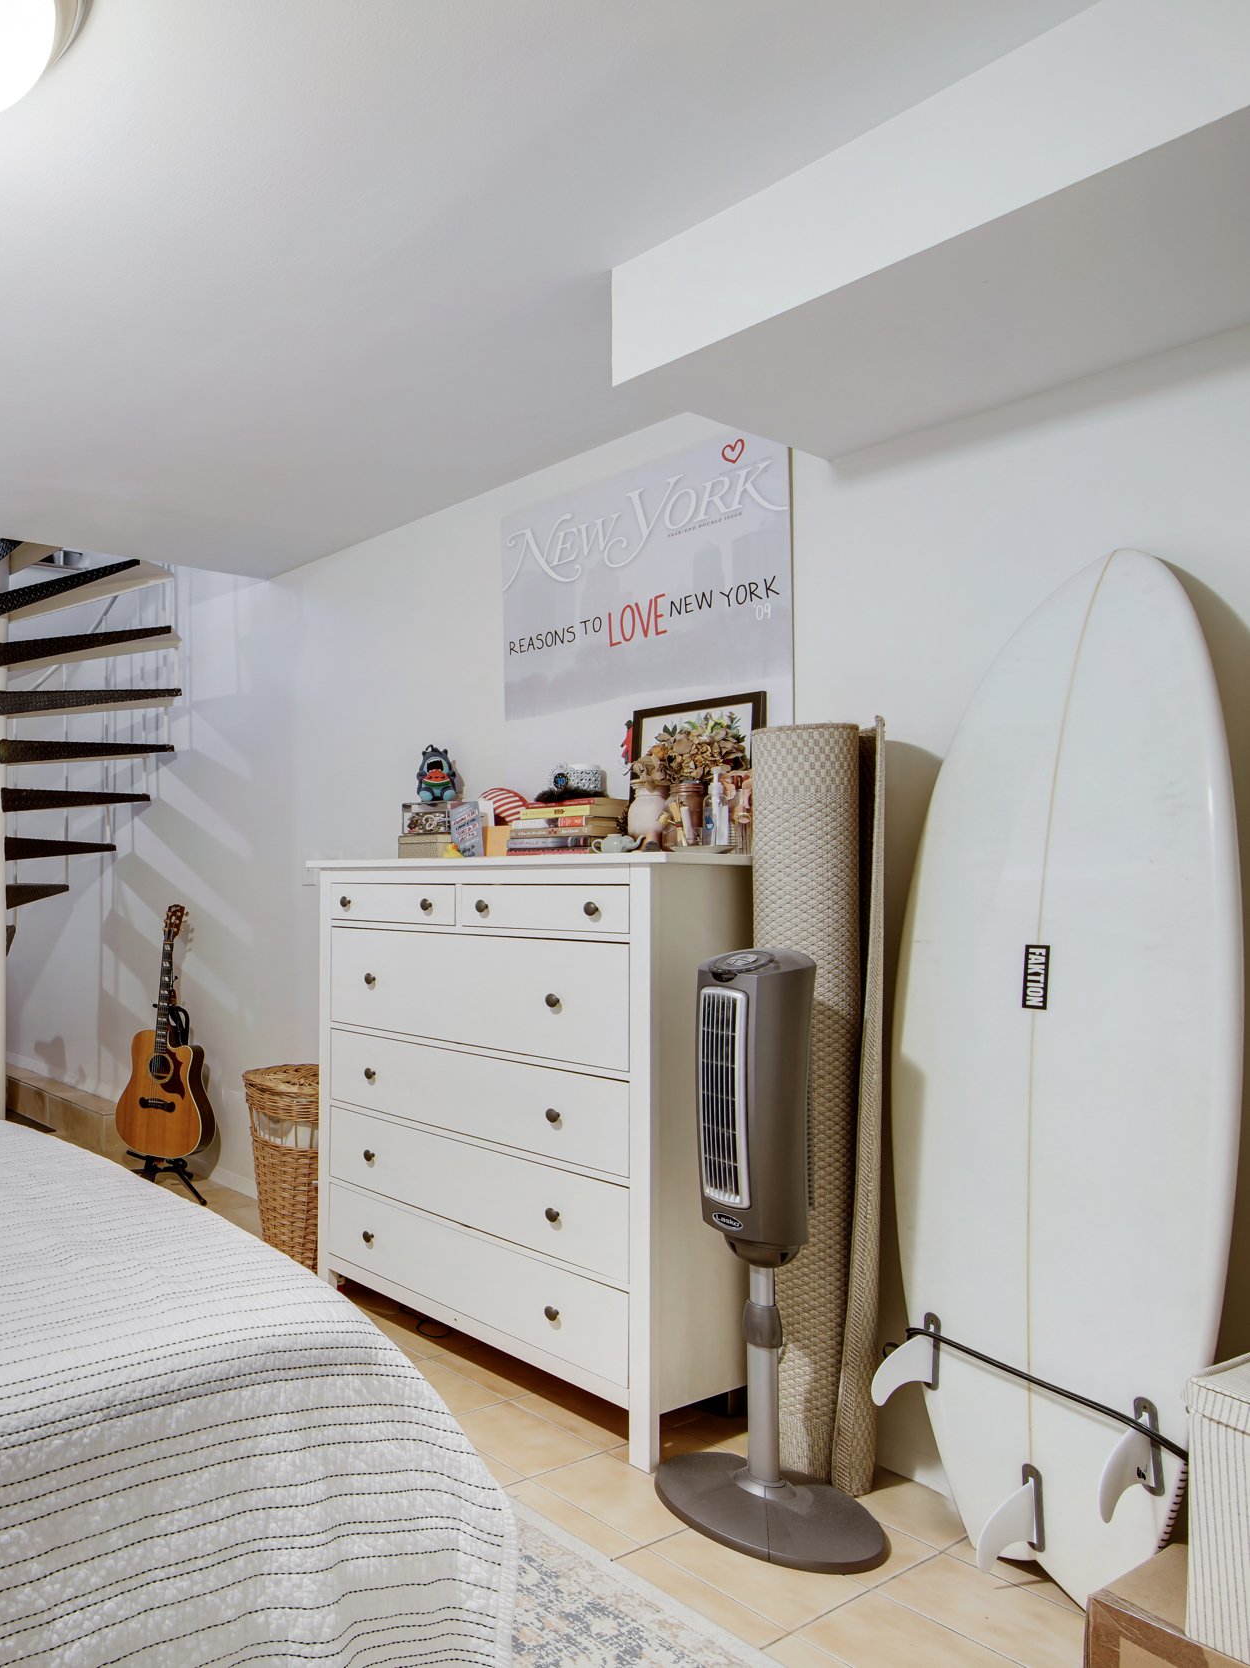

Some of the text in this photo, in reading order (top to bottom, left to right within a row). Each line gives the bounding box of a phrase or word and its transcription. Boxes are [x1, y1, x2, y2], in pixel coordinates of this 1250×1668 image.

[667, 511, 743, 538] YEAR-END DOUBLE ISSUE
[508, 575, 780, 656] REASONS TO LOVE NEW YORK
[555, 777, 566, 786] 30
[1025, 947, 1047, 1007] FAKTION
[715, 1213, 741, 1228] Lasko
